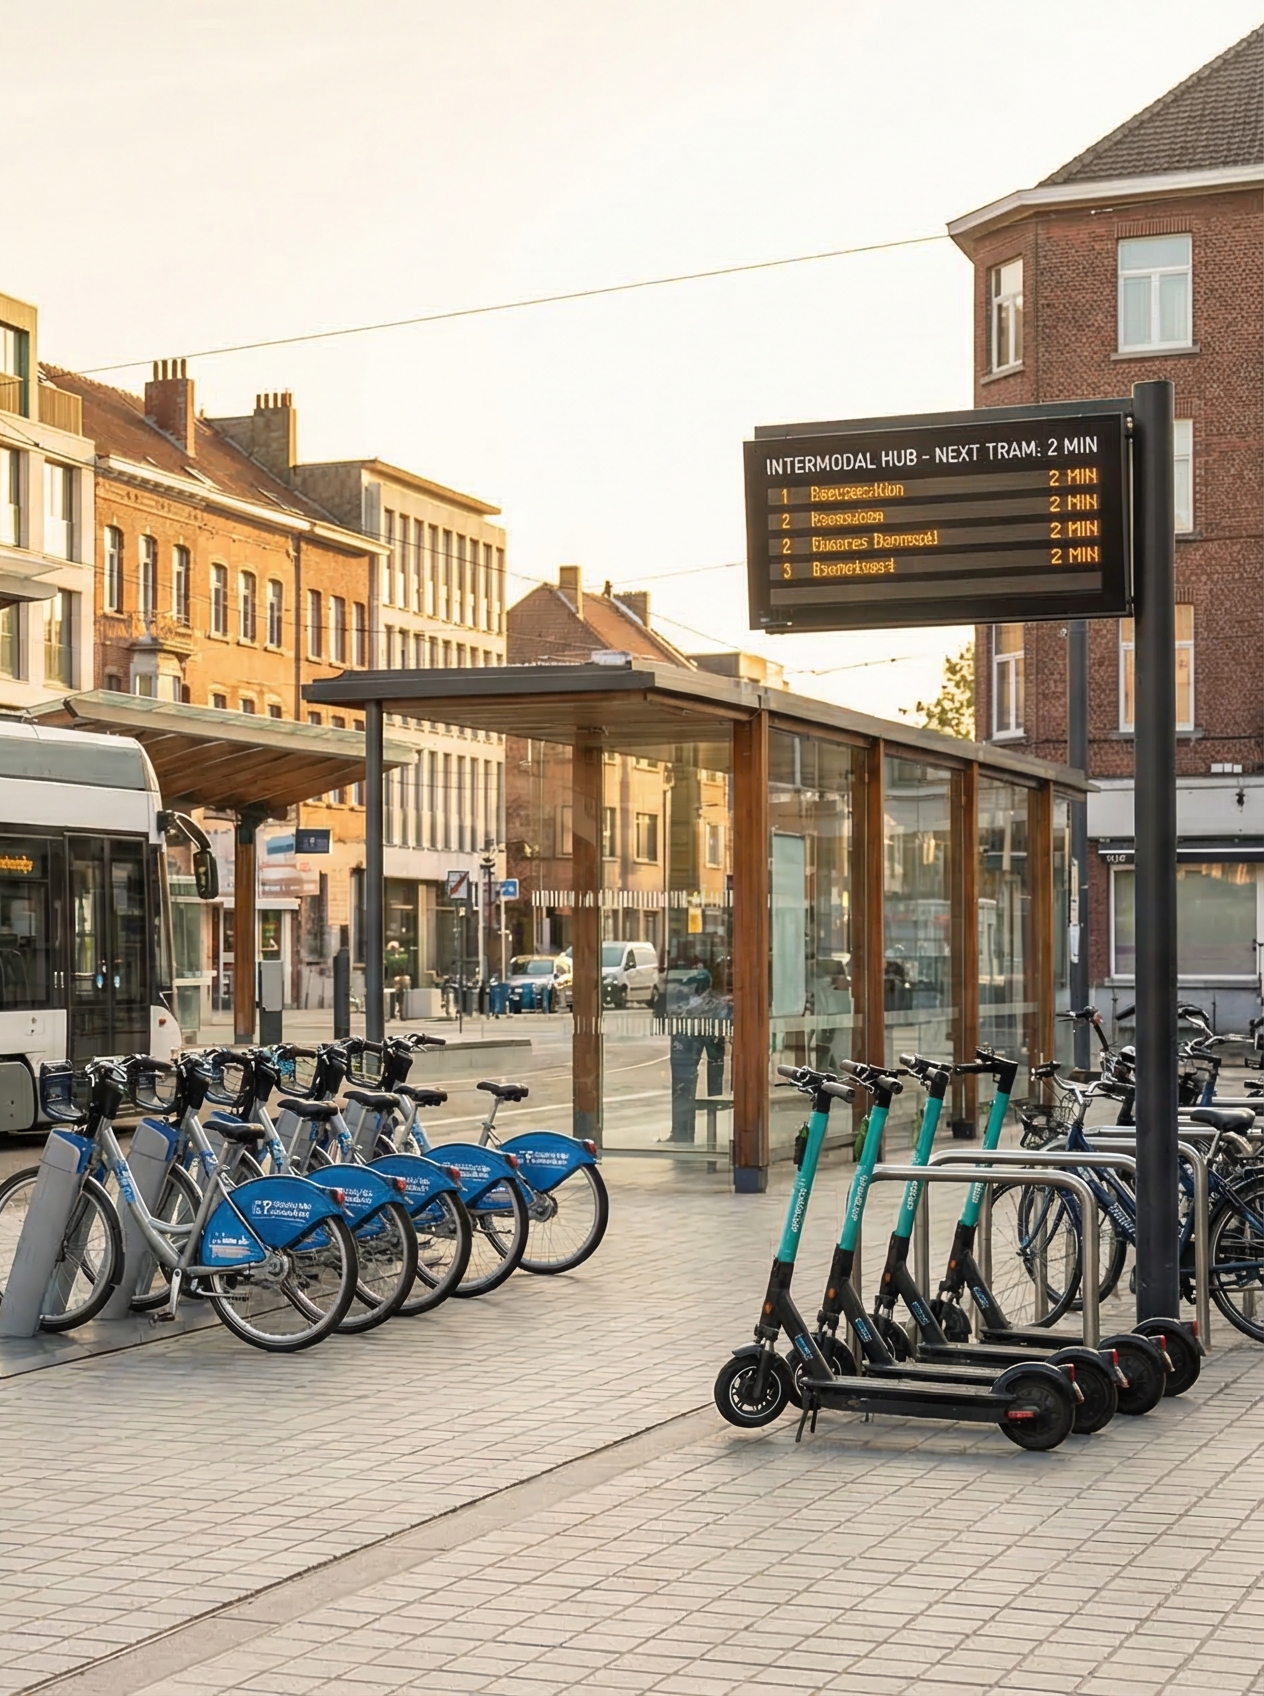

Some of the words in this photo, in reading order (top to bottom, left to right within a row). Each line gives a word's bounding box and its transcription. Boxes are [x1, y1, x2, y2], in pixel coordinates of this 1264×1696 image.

[766, 452, 876, 475] INTERMODAL
[881, 449, 917, 467] HUB
[935, 444, 980, 463] NEXT
[1047, 438, 1058, 456] 2
[1064, 436, 1098, 455] MIN
[781, 488, 788, 504] 1
[1049, 469, 1060, 487] 2
[1067, 467, 1097, 485] MIN
[782, 513, 790, 529] 2
[1049, 496, 1061, 512] 2
[1067, 494, 1097, 511] MIN
[782, 538, 792, 554] 2
[1050, 522, 1062, 539] 2
[1068, 520, 1098, 538] MIN
[1051, 548, 1063, 565] 2
[1069, 546, 1099, 564] MIN
